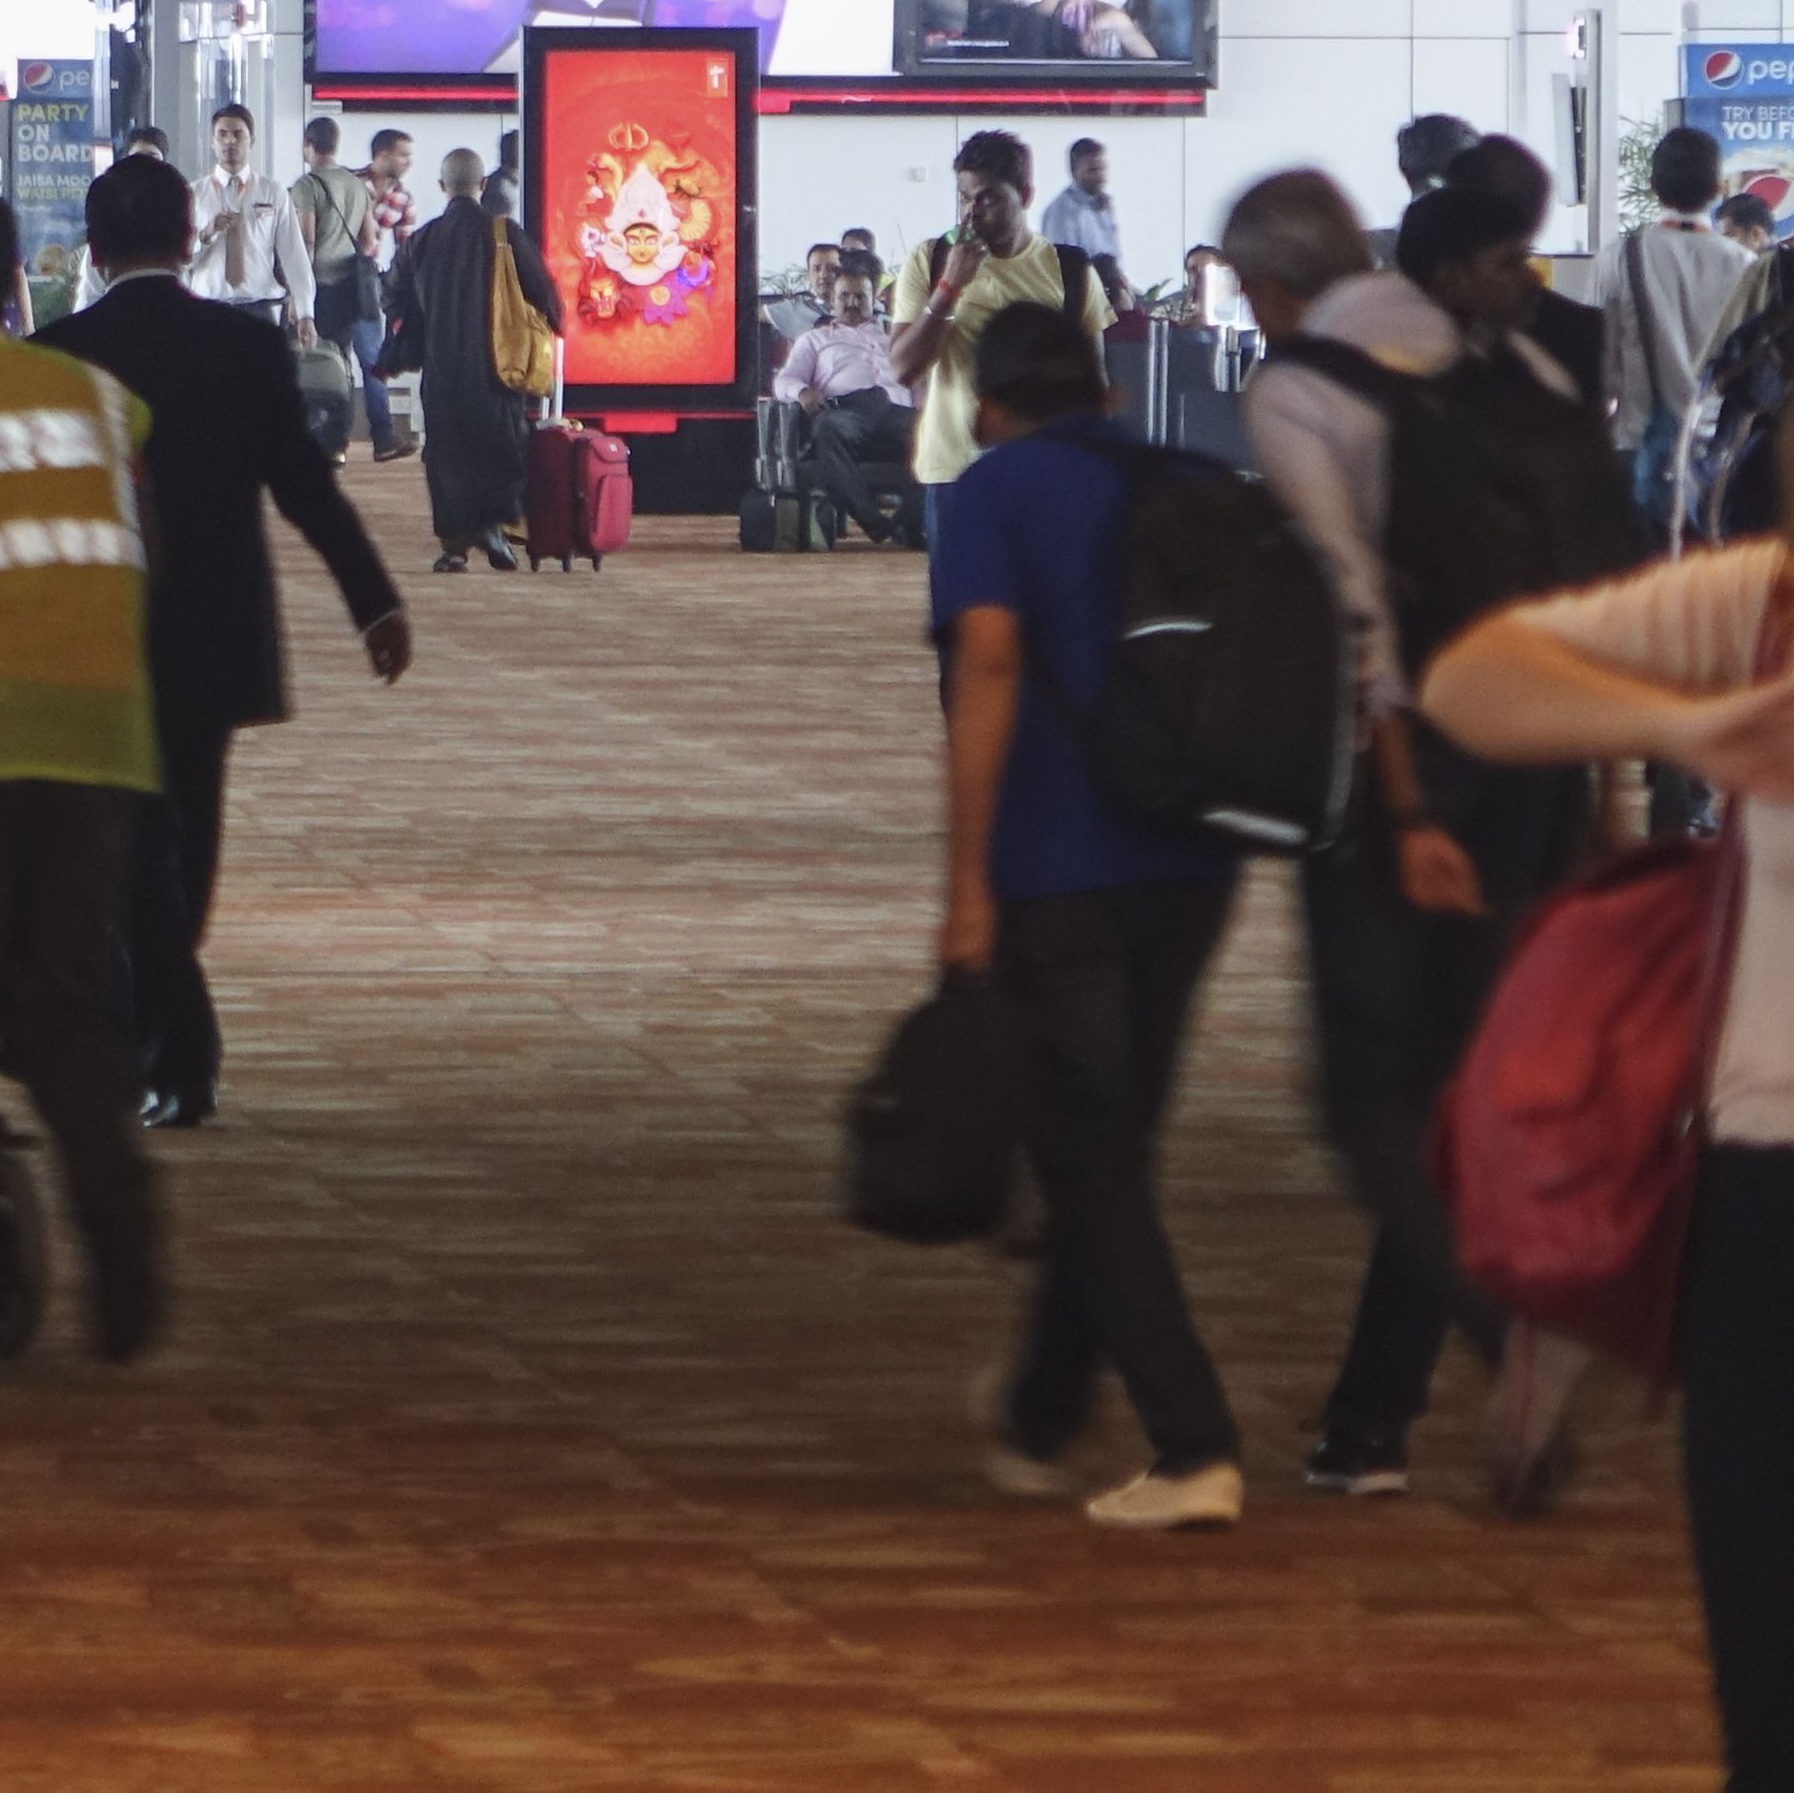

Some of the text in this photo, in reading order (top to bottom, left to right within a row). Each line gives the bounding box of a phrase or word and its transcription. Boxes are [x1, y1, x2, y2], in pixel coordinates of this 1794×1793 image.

[18, 104, 89, 122] PARTY
[1722, 106, 1754, 121] TRY
[18, 124, 50, 142] ON
[1722, 122, 1773, 140] YOU
[18, 144, 94, 162] BOARD
[57, 175, 91, 187] MOO
